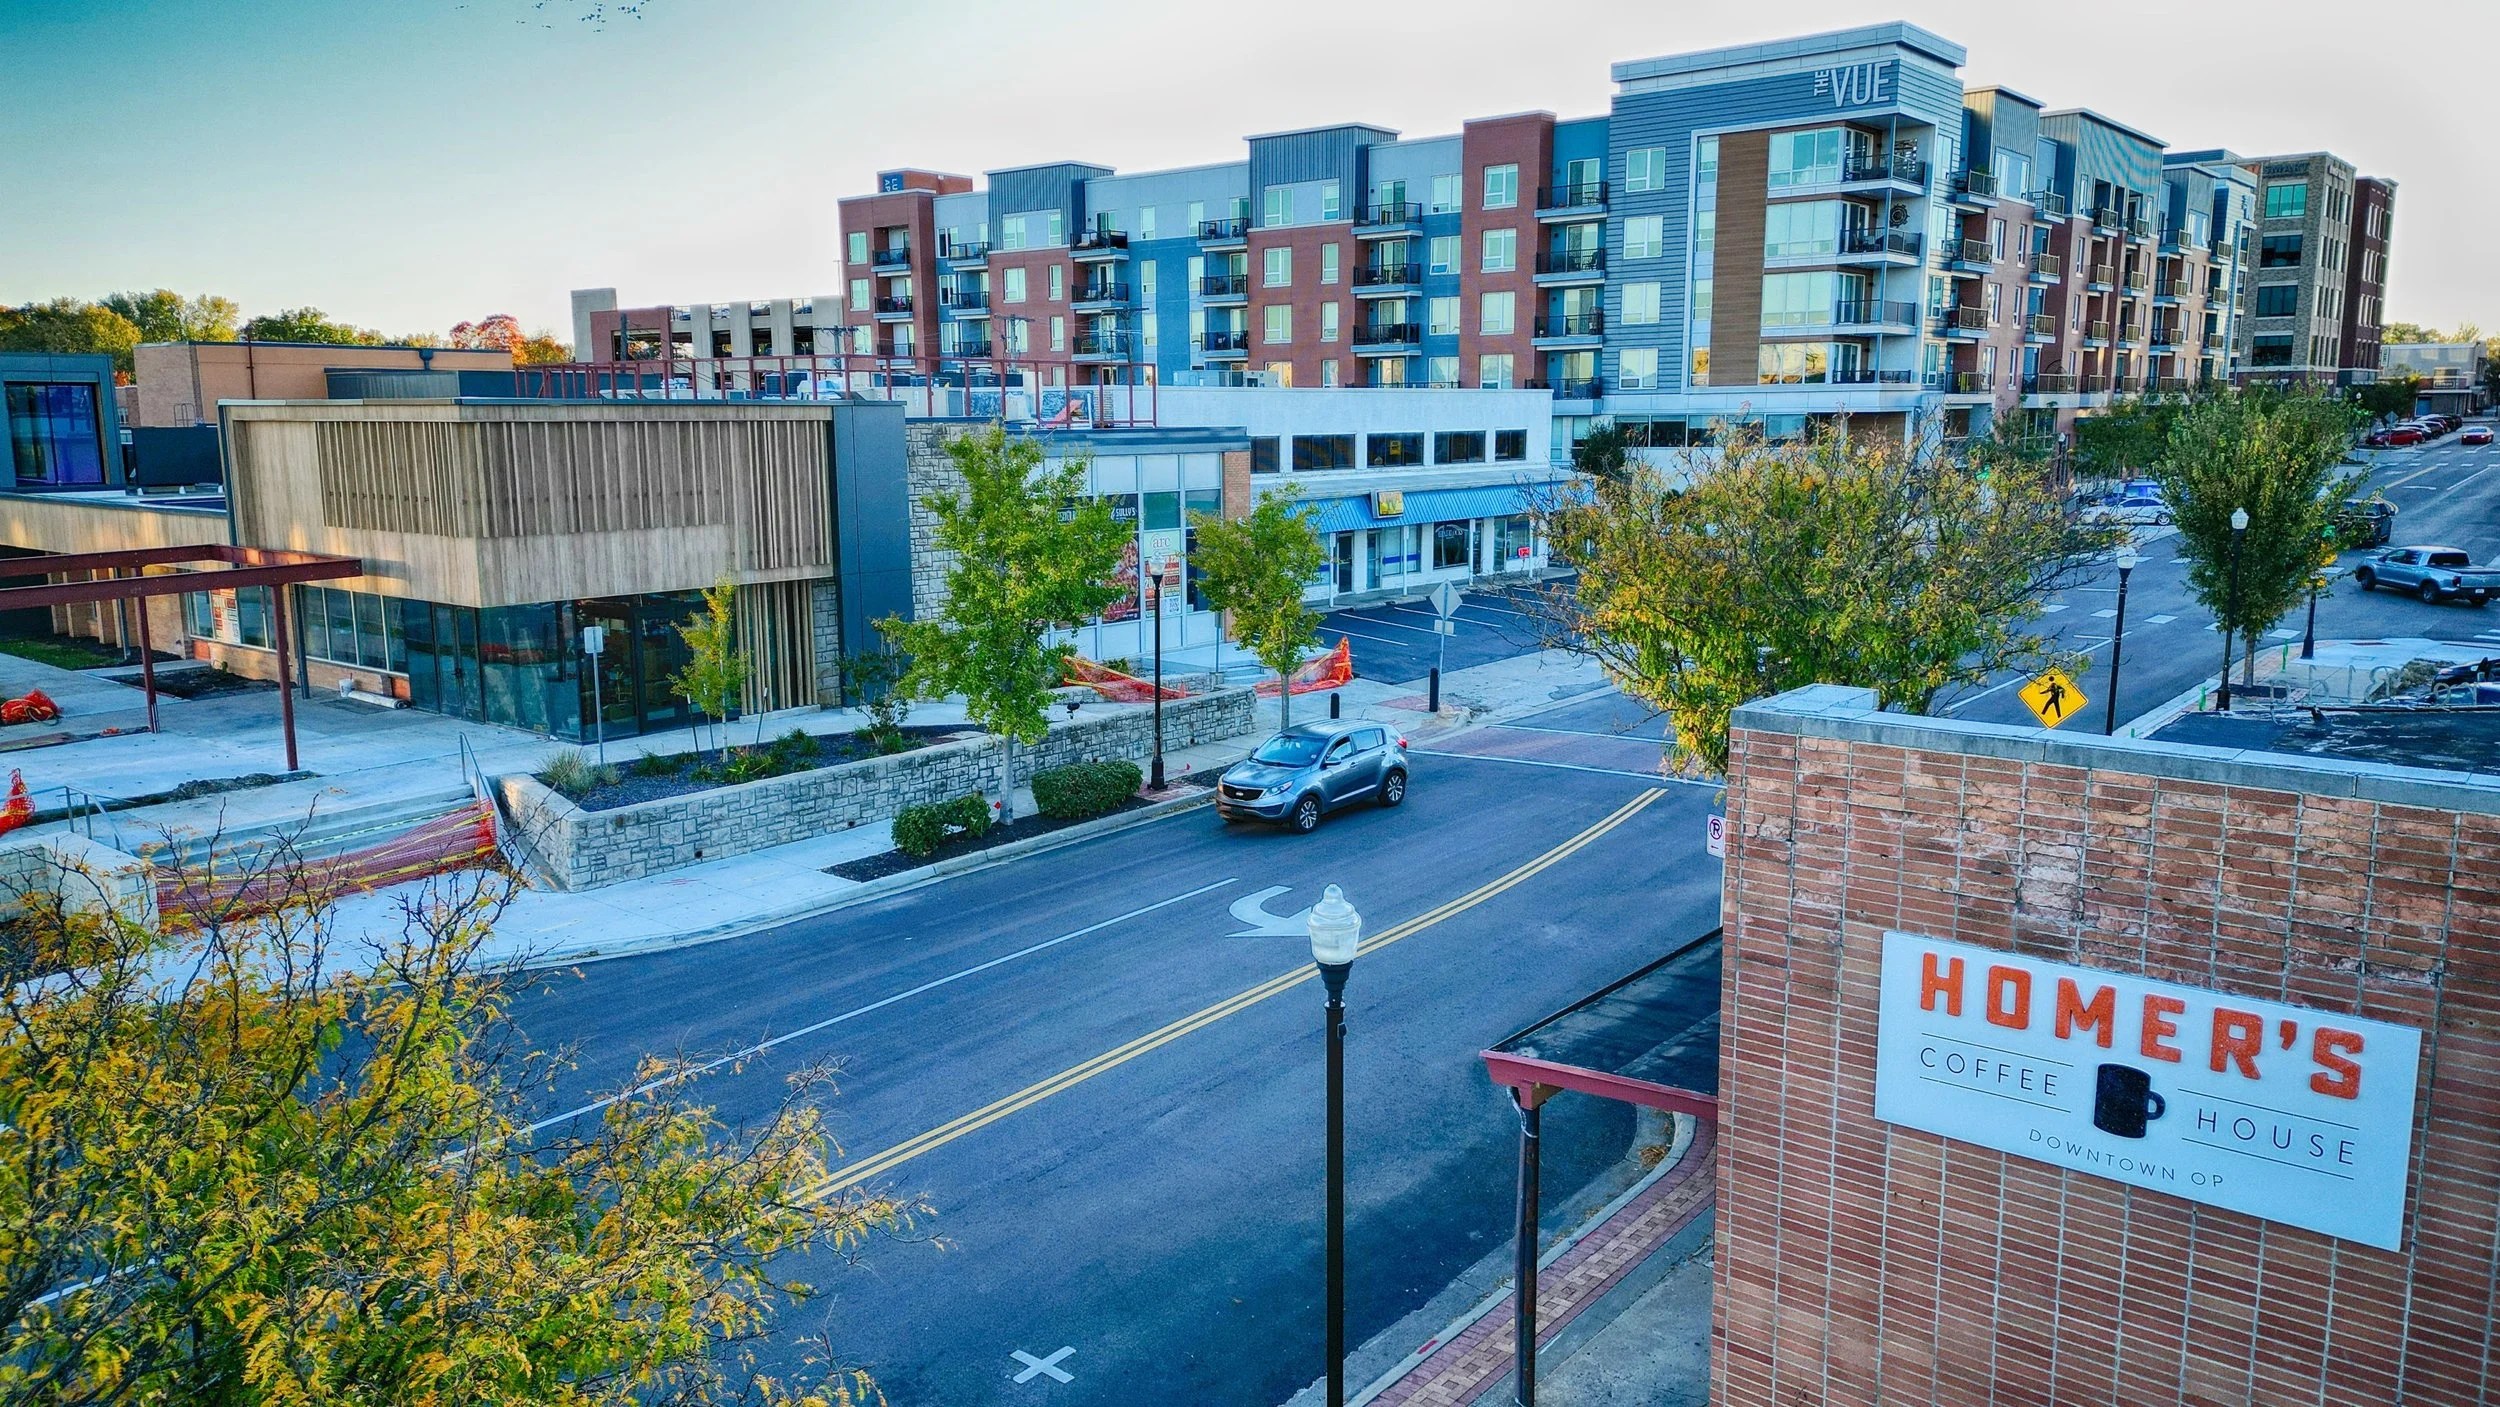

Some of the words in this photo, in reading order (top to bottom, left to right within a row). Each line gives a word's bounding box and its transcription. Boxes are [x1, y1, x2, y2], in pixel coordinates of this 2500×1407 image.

[1814, 70, 1829, 96] THE
[1831, 61, 1892, 107] VUE
[1920, 952, 2364, 1100] HOMER'S
[1920, 1047, 2058, 1096] COFFEE
[2197, 1108, 2356, 1166] HOUSE
[2029, 1128, 2175, 1181] DOWNTOWN
[2191, 1171, 2224, 1187] OP
